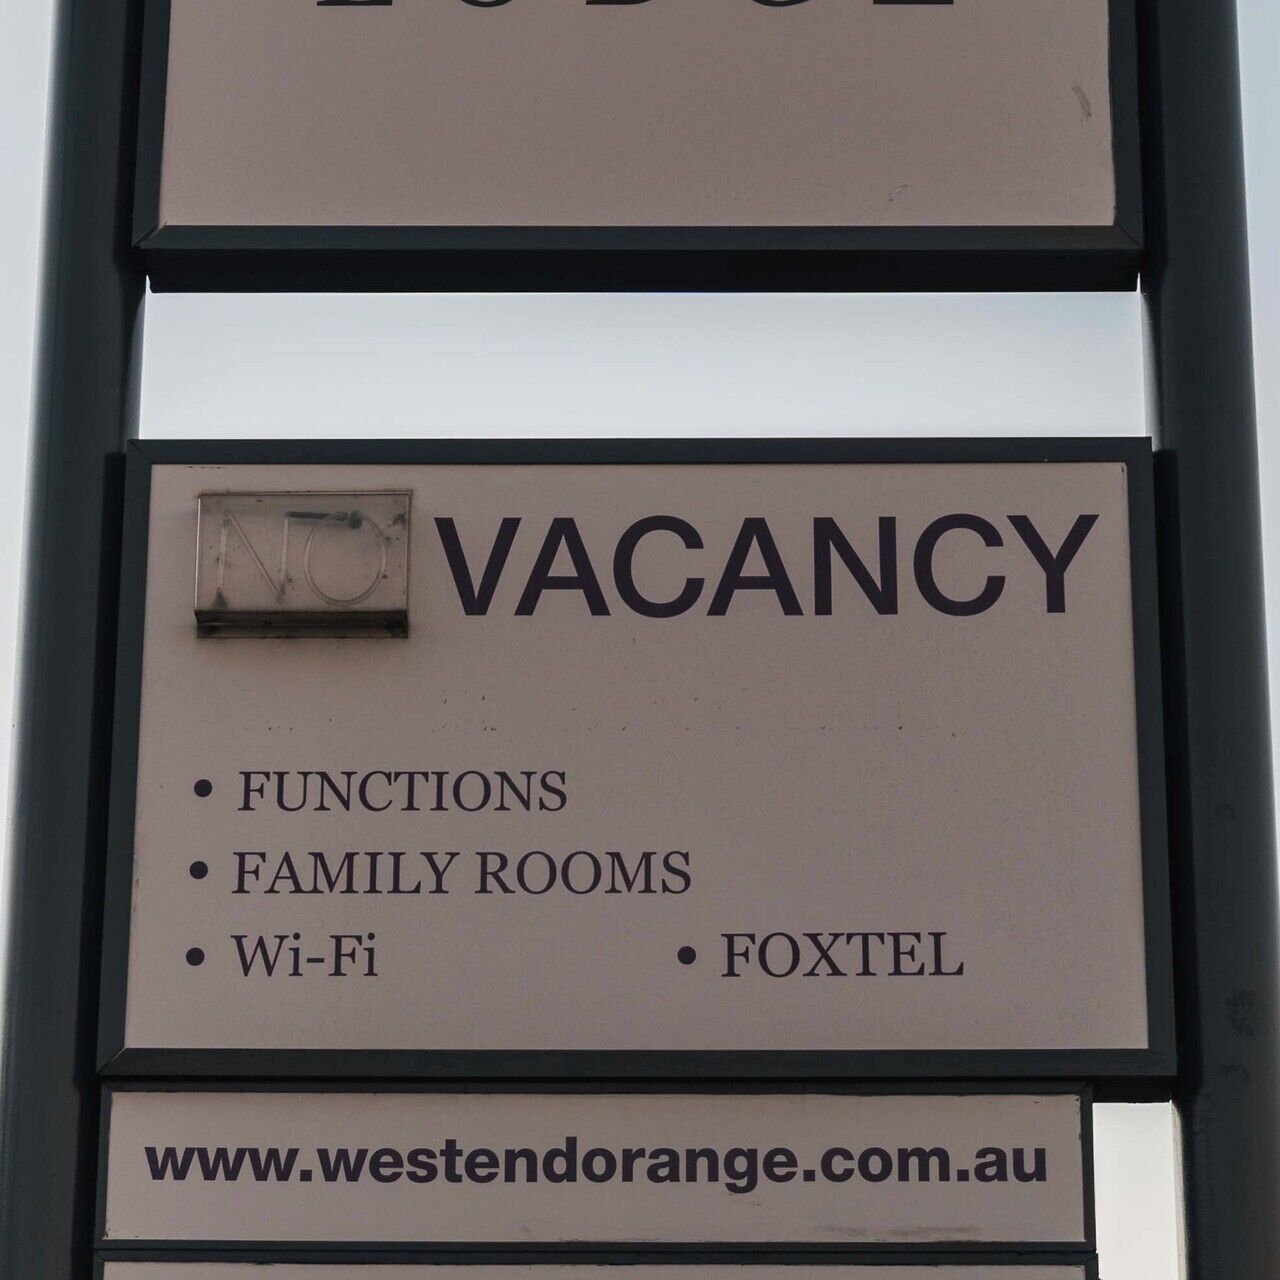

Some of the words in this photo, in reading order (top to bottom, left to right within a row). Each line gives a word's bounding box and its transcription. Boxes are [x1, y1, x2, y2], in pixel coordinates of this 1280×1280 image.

[214, 509, 387, 607] NO
[433, 513, 1100, 619] VACANCY
[236, 769, 568, 813] FUNCTIONS
[231, 850, 459, 895] FAMILY
[474, 849, 692, 895] ROOMS
[230, 931, 379, 978] Wi-Fi
[720, 931, 965, 979] FOXTEL
[144, 1135, 1048, 1195] www.westendorange.com.au
